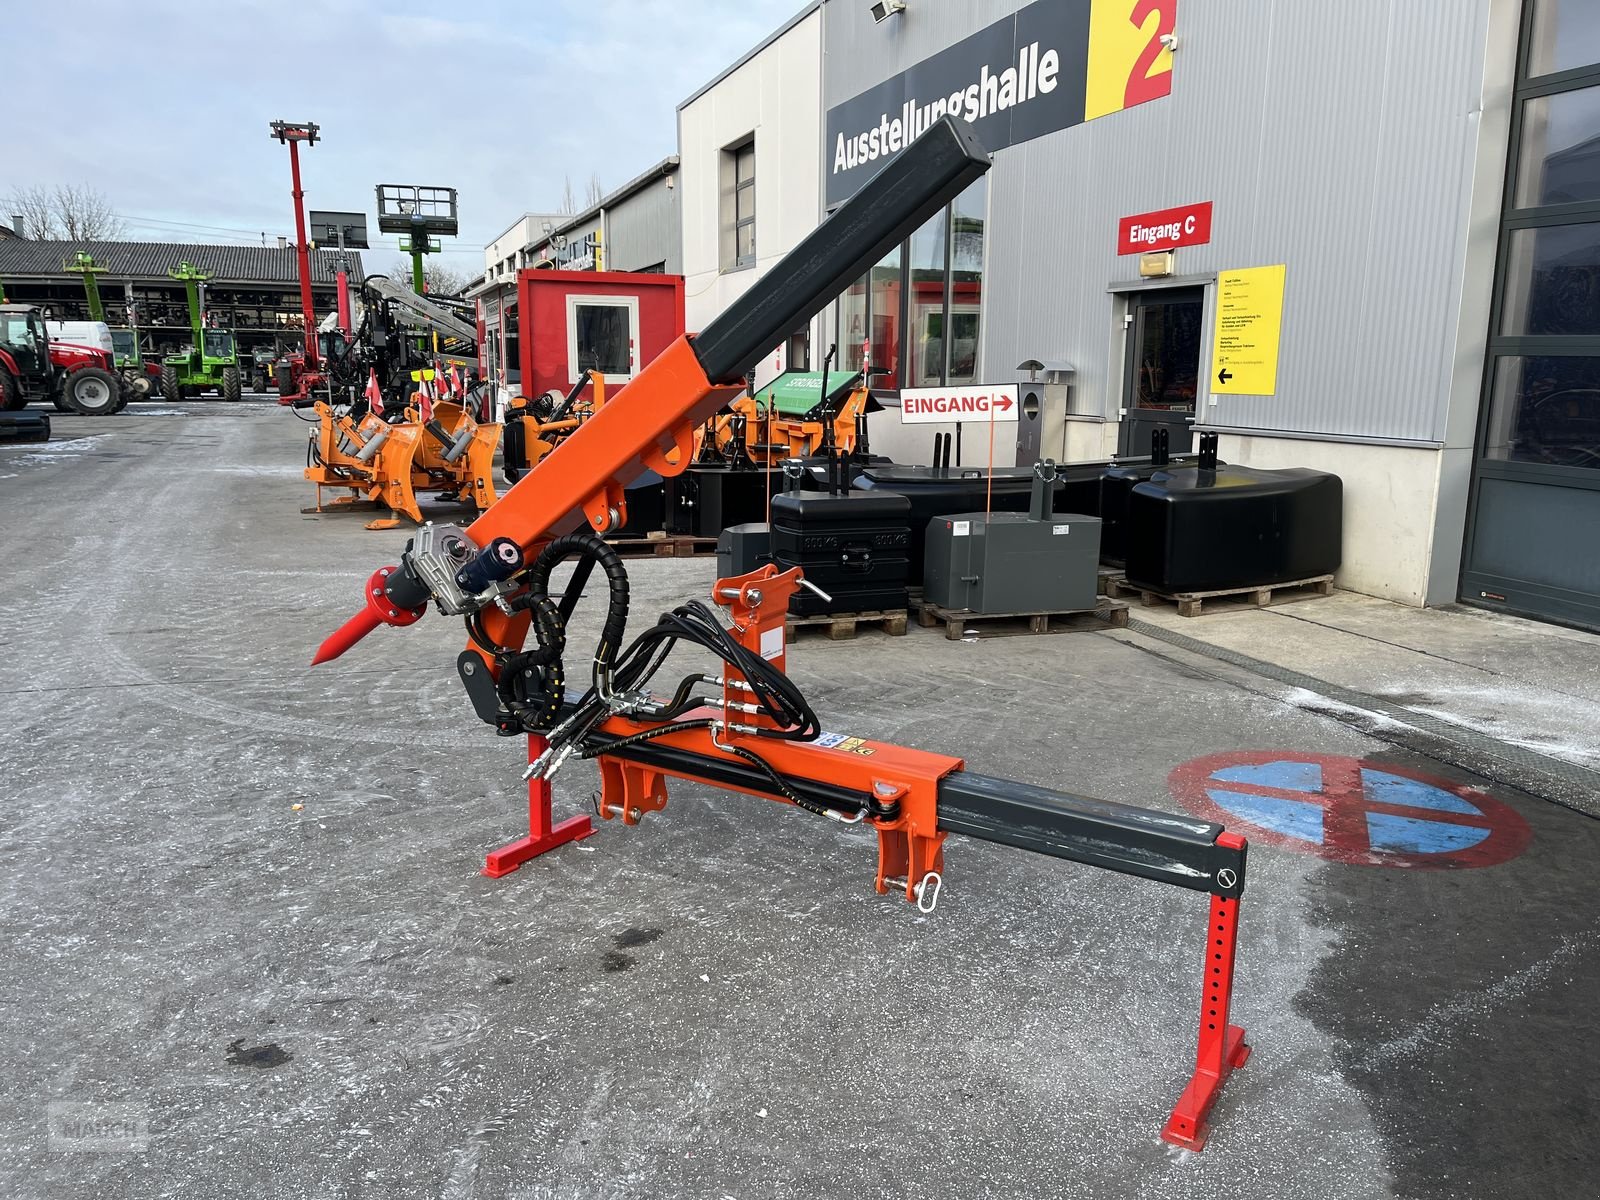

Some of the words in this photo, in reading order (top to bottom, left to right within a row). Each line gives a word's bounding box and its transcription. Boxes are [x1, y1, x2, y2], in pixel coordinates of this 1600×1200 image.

[833, 41, 1059, 174] Ausstellungshalle
[1123, 0, 1177, 109] 2
[1130, 222, 1181, 243] Eingang
[1184, 215, 1195, 234] C
[904, 397, 989, 413] EINGANG
